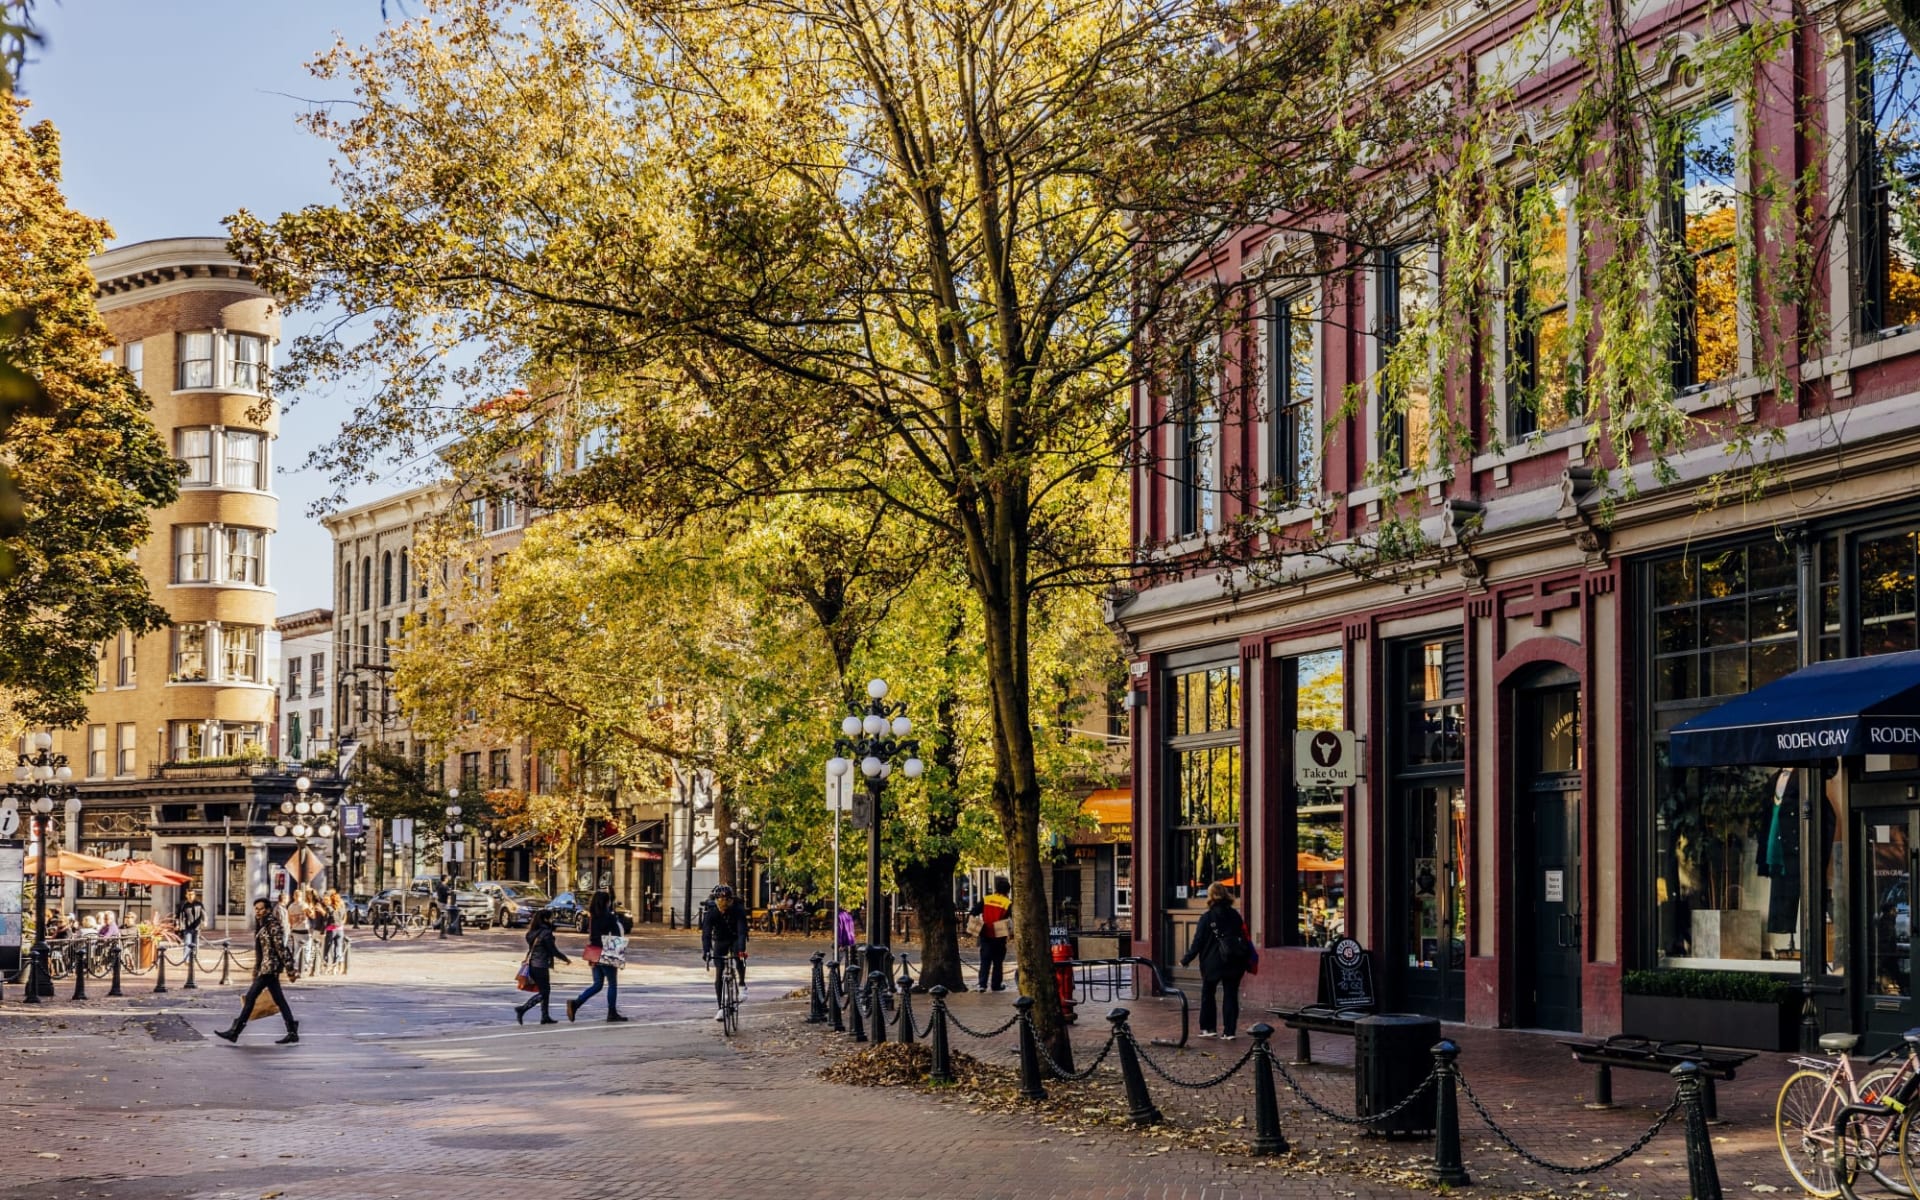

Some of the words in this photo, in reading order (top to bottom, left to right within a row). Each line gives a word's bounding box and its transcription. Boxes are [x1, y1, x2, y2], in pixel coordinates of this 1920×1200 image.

[1777, 732, 1816, 749] RODEN
[1818, 728, 1850, 746] GRAY
[1302, 768, 1327, 778] Take
[1329, 768, 1347, 778] Out
[1074, 847, 1096, 858] ATM
